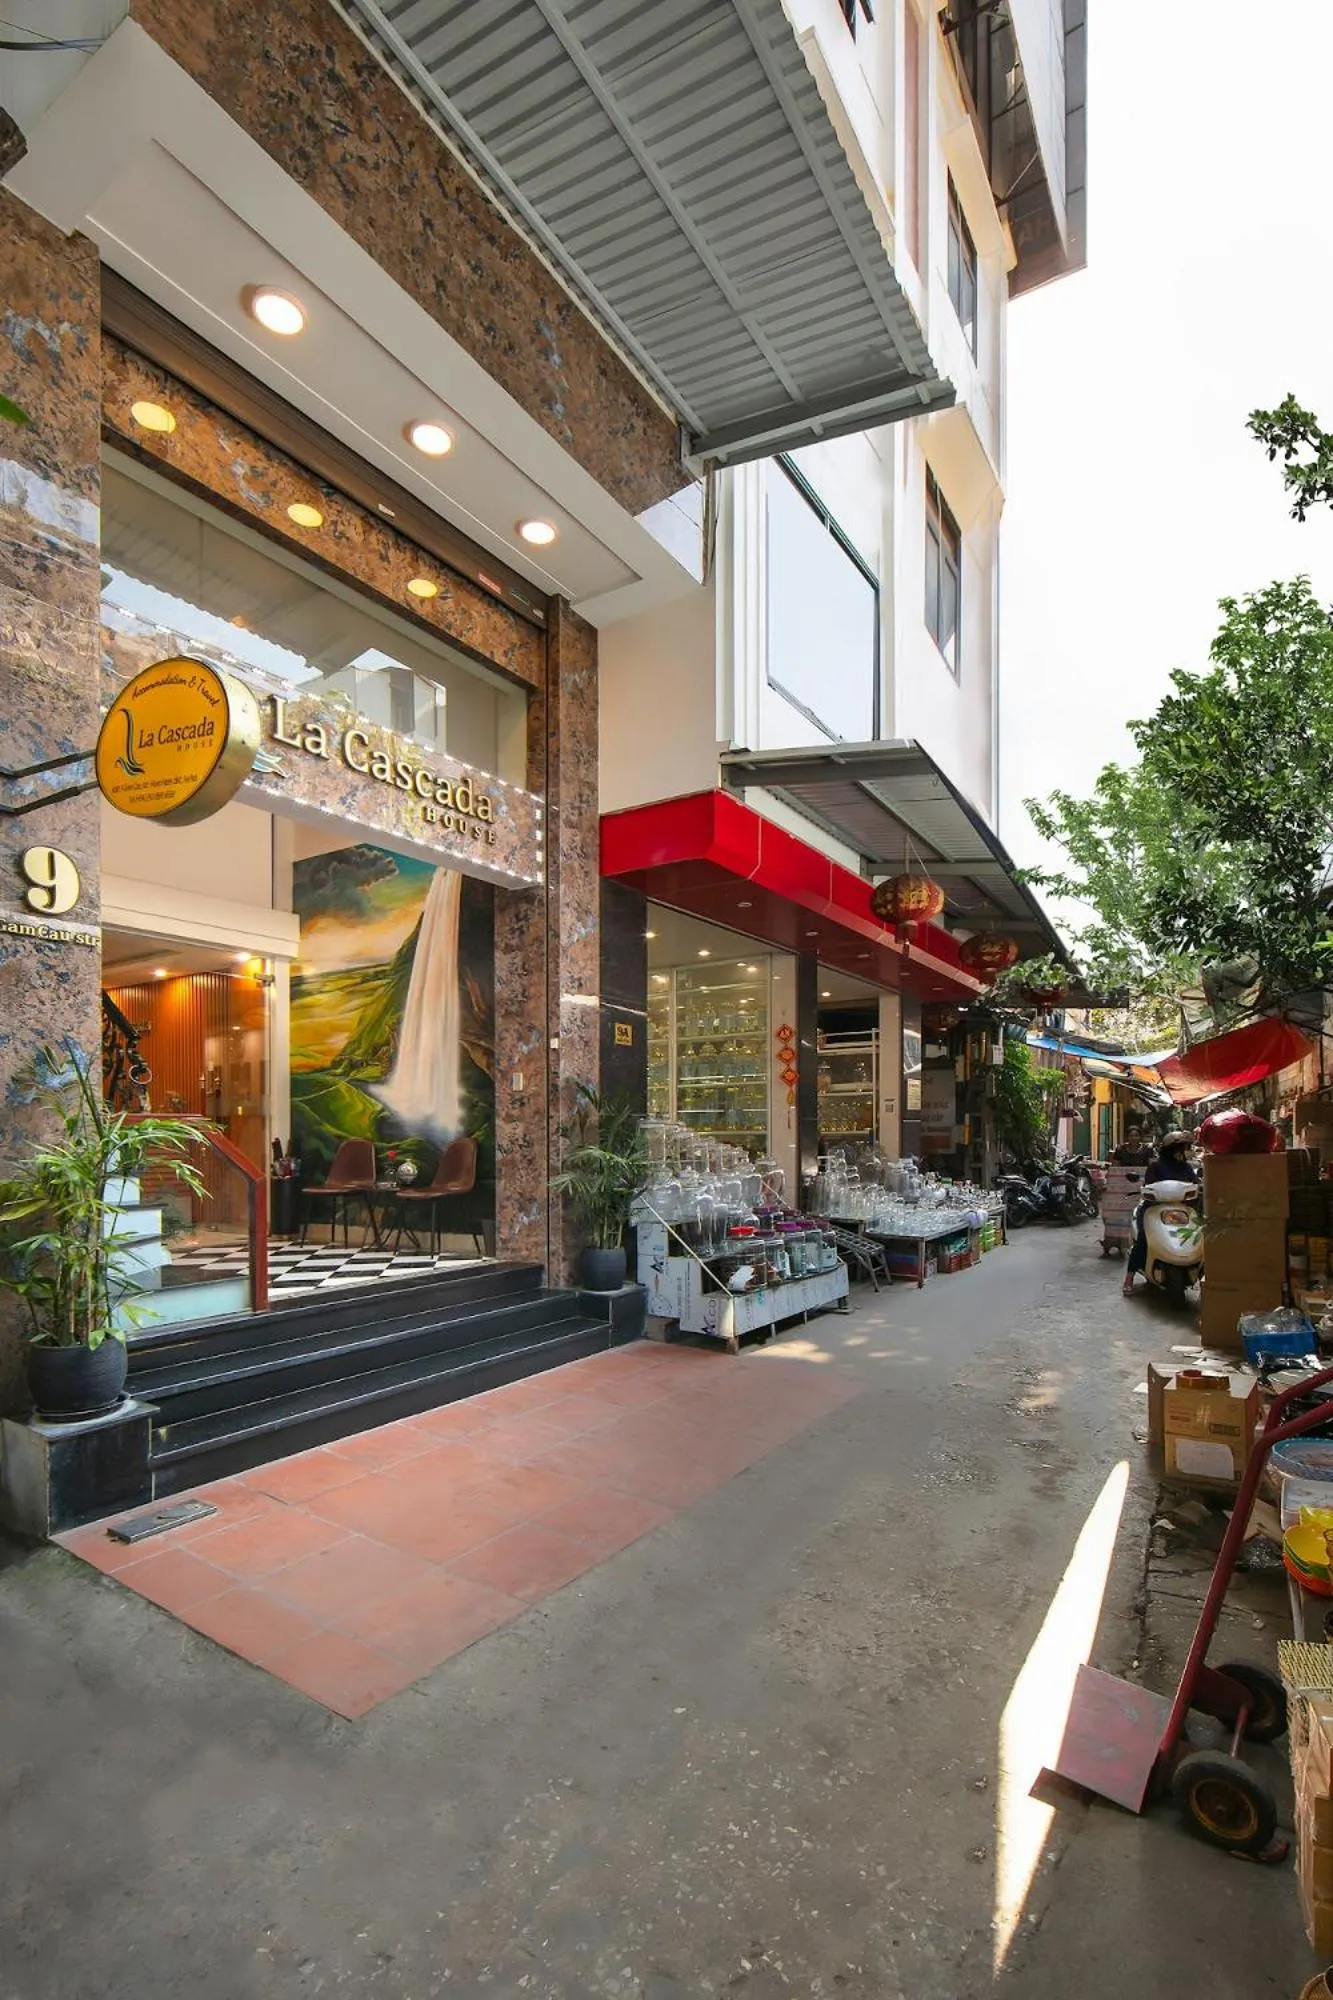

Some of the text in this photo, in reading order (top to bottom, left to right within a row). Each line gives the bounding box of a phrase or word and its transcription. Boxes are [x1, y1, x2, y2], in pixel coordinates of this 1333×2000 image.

[188, 676, 197, 688] &
[138, 716, 214, 748] La Cascada
[270, 695, 494, 824] La Cascada
[426, 805, 497, 845] HOUSE
[23, 845, 80, 914] 9
